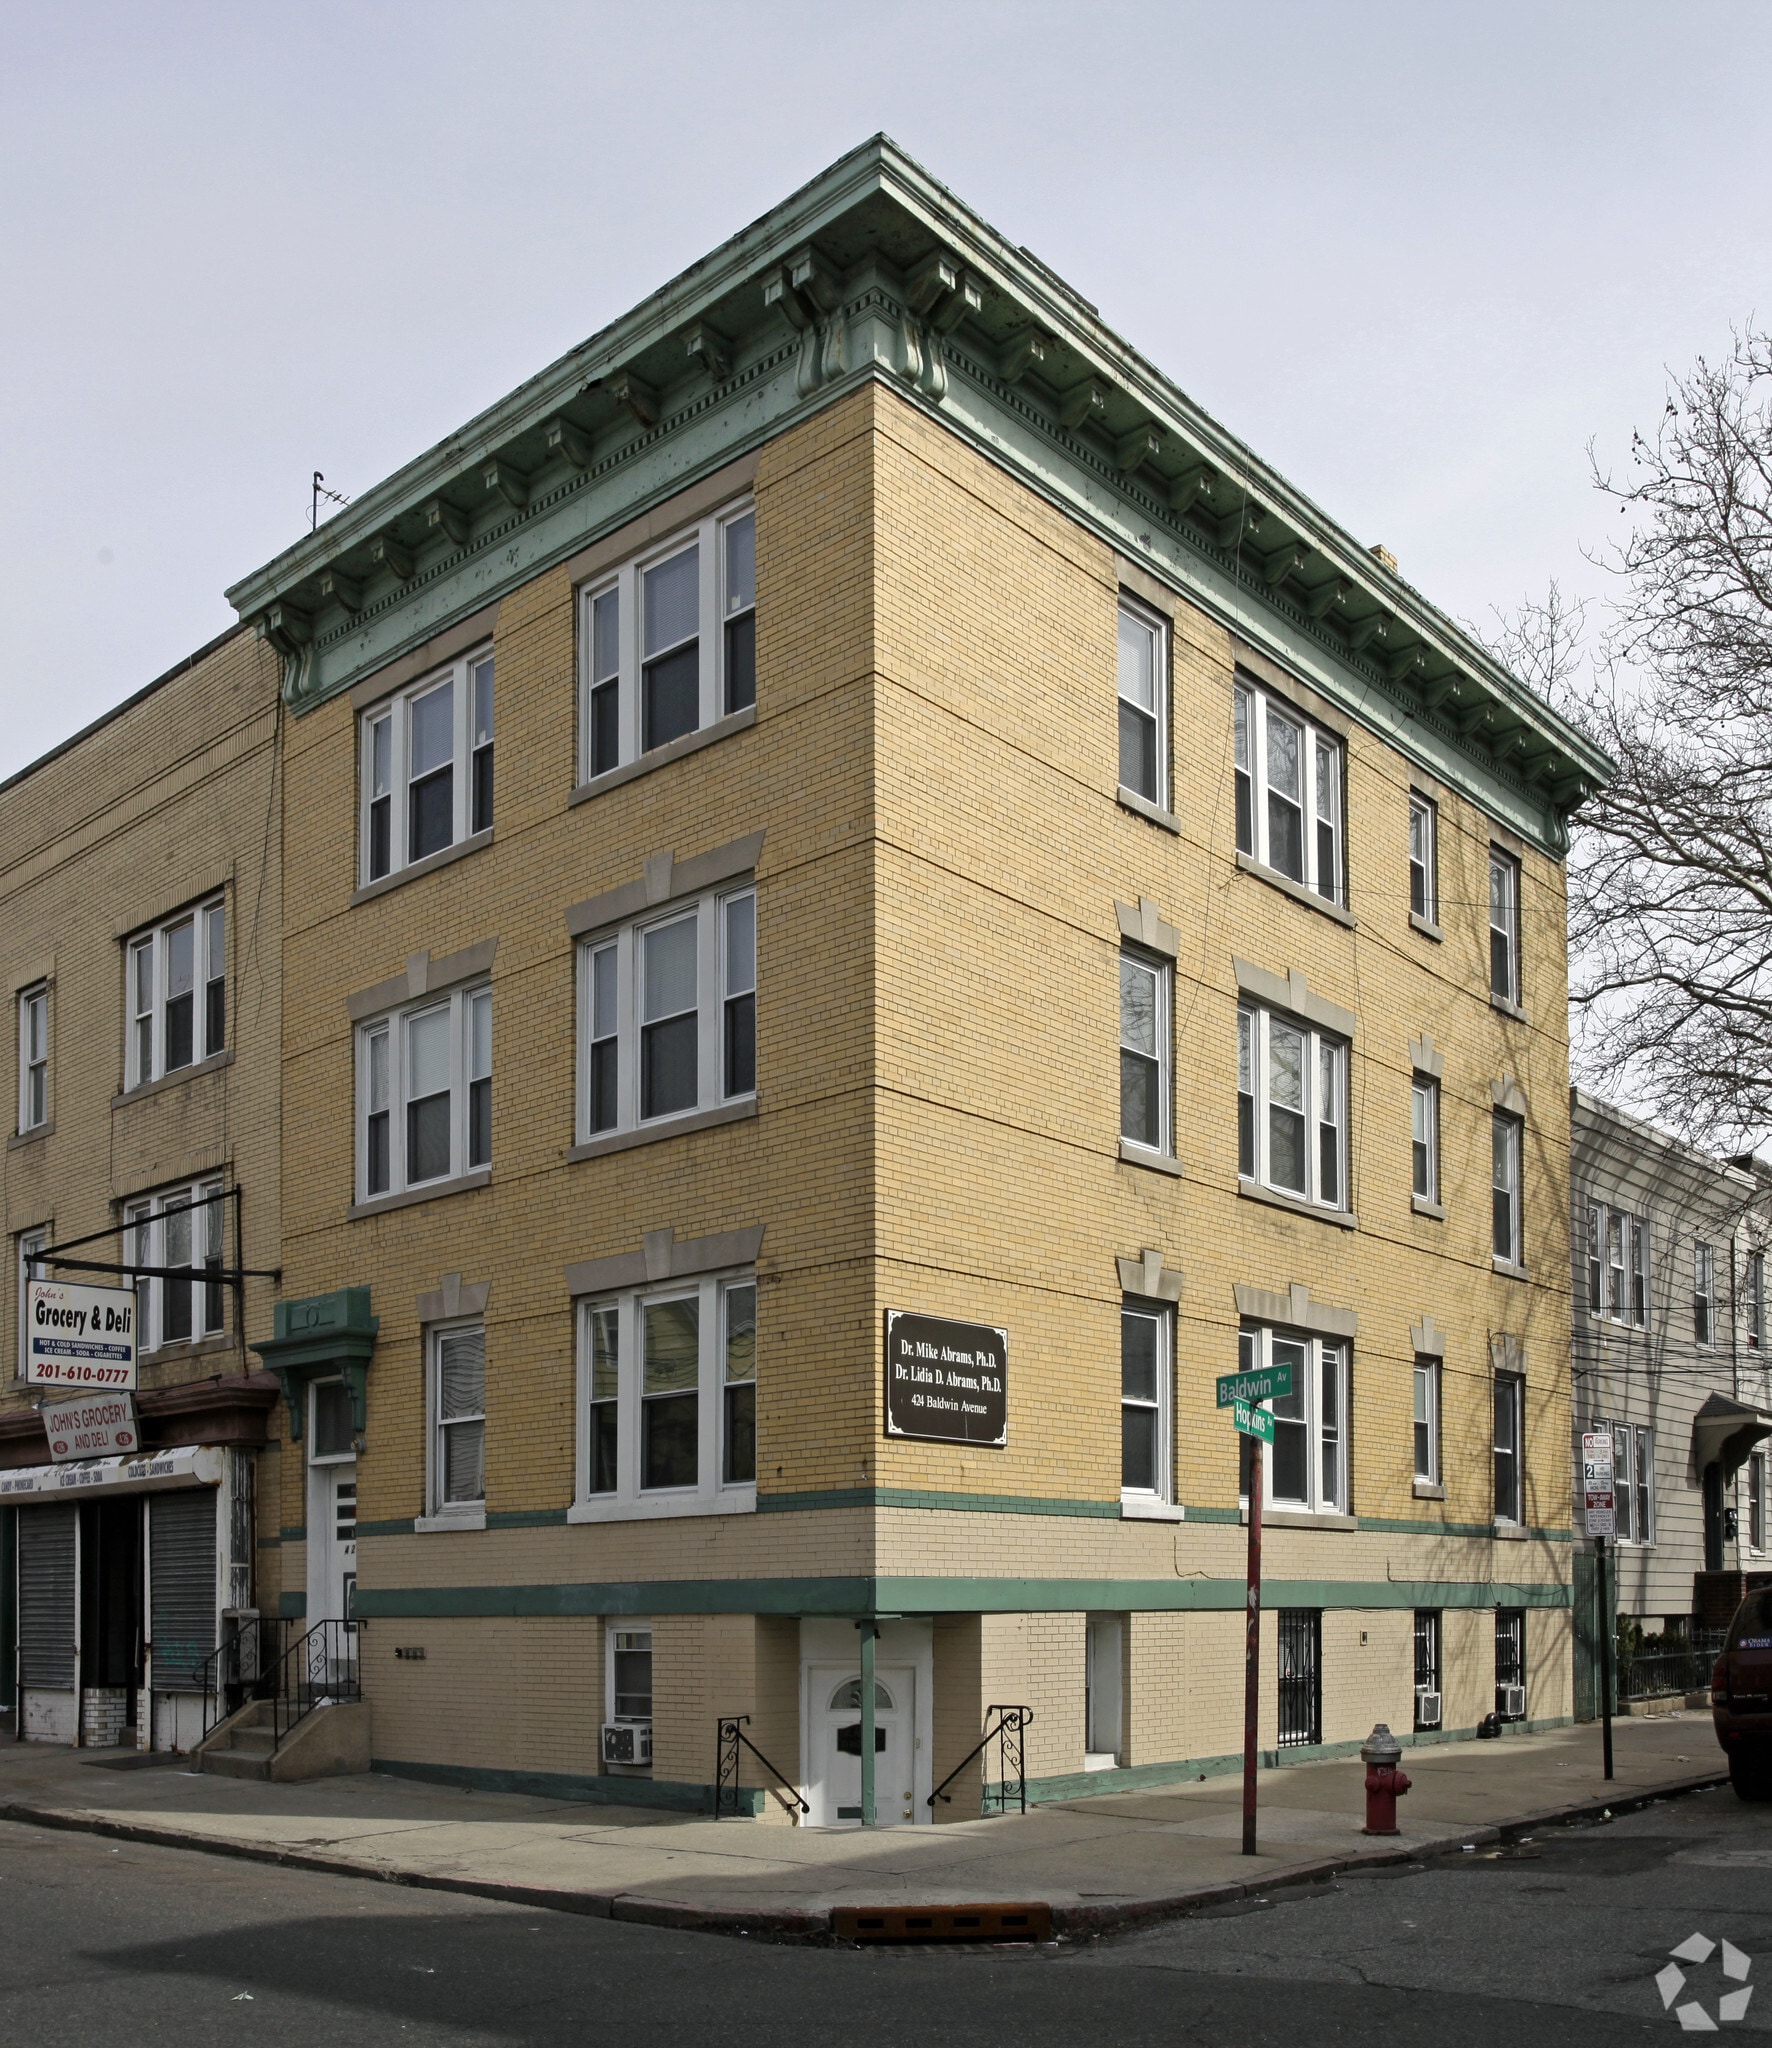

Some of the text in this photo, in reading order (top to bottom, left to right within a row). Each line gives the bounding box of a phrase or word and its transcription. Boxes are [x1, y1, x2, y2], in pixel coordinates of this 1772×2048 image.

[35, 1286, 64, 1301] John's
[36, 1300, 131, 1336] Grocery & Deli
[72, 1342, 104, 1350] SANDWICHES
[94, 1351, 122, 1359] CIGARETTES
[900, 1339, 996, 1368] Dr. Mike Abrams, Ph.D.
[36, 1363, 128, 1383] 201-610-0777
[895, 1363, 1002, 1392] Dr. Lidia D. Abrams, Ph.D.
[1220, 1372, 1286, 1402] Baldwin Av
[911, 1394, 987, 1414] 424 Baldwin Avenue
[50, 1403, 126, 1432] JOHN'S GROCERY
[1236, 1401, 1265, 1432] Hopkins
[75, 1431, 109, 1450] AND DELI
[1585, 1438, 1594, 1447] NO
[1586, 1465, 1593, 1478] 2
